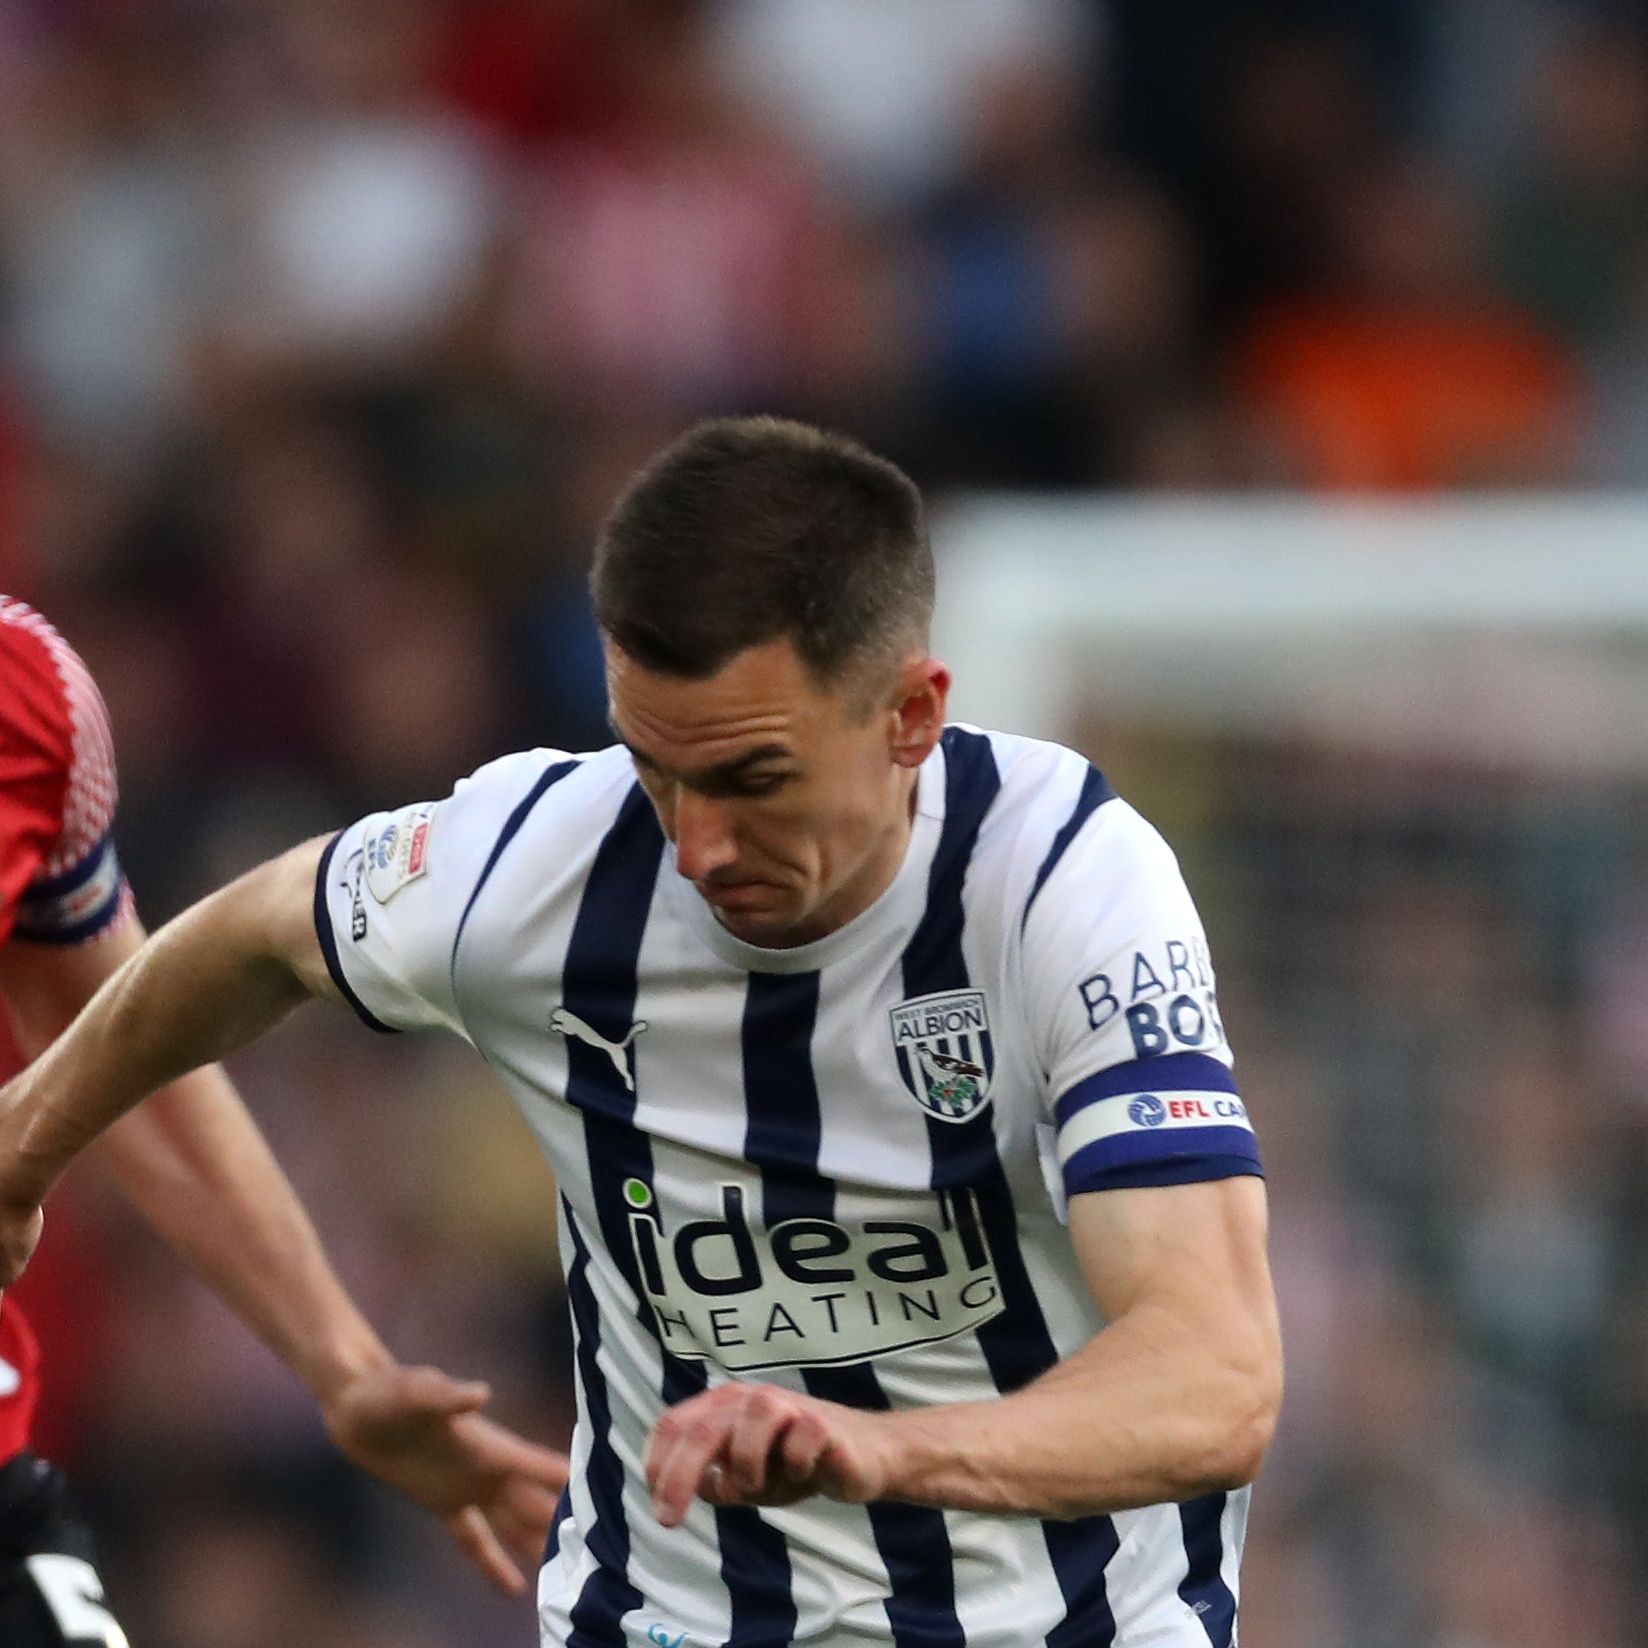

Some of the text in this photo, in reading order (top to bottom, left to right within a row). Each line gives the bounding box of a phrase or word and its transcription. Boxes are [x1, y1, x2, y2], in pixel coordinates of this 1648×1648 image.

[899, 1007, 982, 1041] ALBION
[1167, 1100, 1210, 1118] EFL
[623, 1178, 989, 1298] ideal
[655, 1276, 996, 1348] HEATING
